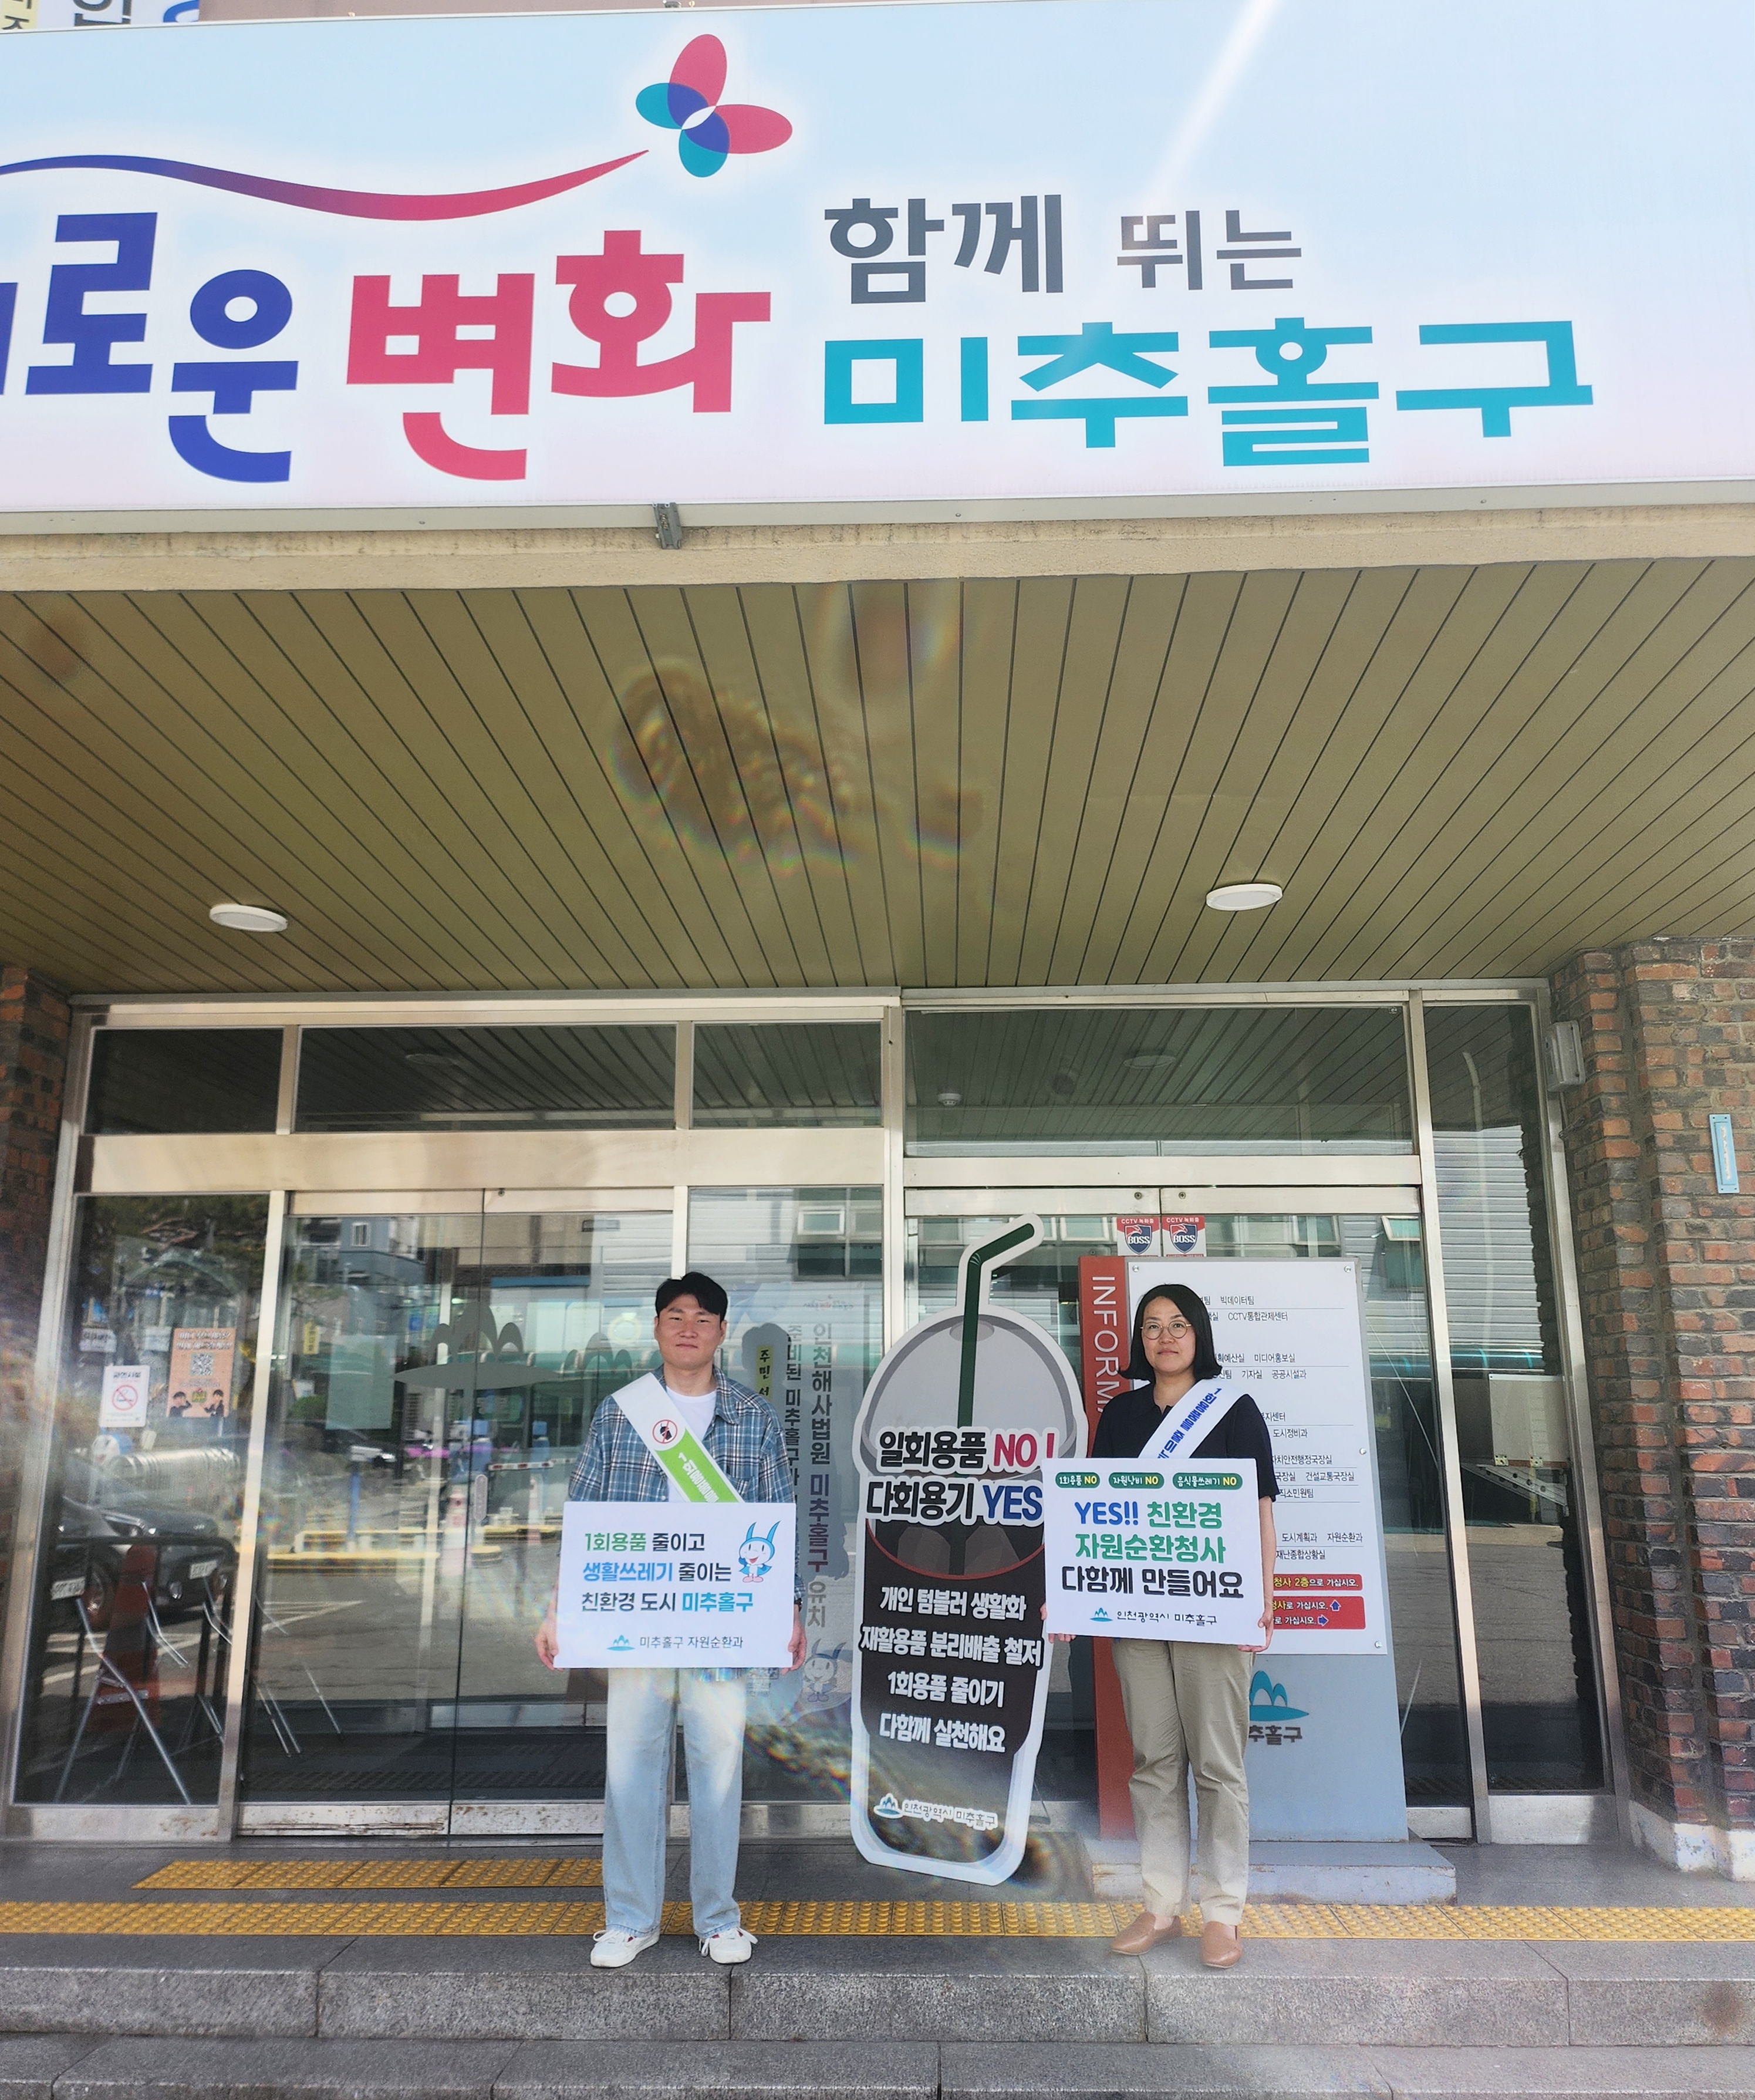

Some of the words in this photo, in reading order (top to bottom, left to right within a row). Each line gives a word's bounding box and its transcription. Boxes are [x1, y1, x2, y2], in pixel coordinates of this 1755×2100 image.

[825, 194, 1063, 304] 함께
[1117, 210, 1302, 291] 뛰는
[0, 213, 299, 483] 로운
[347, 230, 771, 481] 변화
[824, 317, 1593, 466] 미추홀구
[1128, 1236, 1150, 1244] BOSS
[1220, 1296, 1254, 1305] 빅데이터팀
[1228, 1312, 1288, 1321] CCTV통합관제센터
[1092, 1276, 1119, 1413] INFORM
[1215, 1353, 1244, 1363] 획예산실
[1254, 1353, 1295, 1363] 미디어홍보실
[1242, 1370, 1262, 1379] 기자실
[1272, 1370, 1306, 1379] 공공시설과
[811, 1322, 832, 1465] 인천해사법원
[1273, 1428, 1307, 1438] 도시정비과
[880, 1431, 987, 1468] 일회용품
[994, 1434, 1037, 1468] NO
[1059, 1477, 1082, 1485] 1회용품
[1084, 1476, 1098, 1485] NO
[1113, 1476, 1143, 1486] 자원낭비
[1145, 1476, 1159, 1485] NO
[1177, 1477, 1220, 1487] 음식물쓰레기
[1223, 1477, 1237, 1486] NO
[1306, 1472, 1354, 1481] 건설교통국장실
[867, 1481, 974, 1519] 다회용기
[983, 1485, 1042, 1521] YES
[1280, 1488, 1314, 1498] 직소민원팀
[808, 1474, 829, 1573] 미추홀구
[1075, 1501, 1138, 1525] YES!!
[1147, 1502, 1221, 1529] 친환경
[585, 1533, 646, 1551] 1회용품
[653, 1533, 704, 1551] 줄이고
[1282, 1532, 1317, 1542] 도시계획과
[1327, 1532, 1362, 1542] 자원순환과
[1075, 1533, 1226, 1563] 자원순환청사
[1276, 1549, 1325, 1560] 재난종합상황실
[583, 1562, 672, 1581] 생활쓰레기
[679, 1563, 731, 1581] 줄이는
[1062, 1566, 1133, 1593] 다함께
[1142, 1569, 1244, 1598] 만들어요
[1295, 1577, 1324, 1587] 2층으로
[1327, 1579, 1359, 1587] 가십시오.
[582, 1592, 635, 1612] 친환경
[641, 1593, 676, 1611] 도시
[683, 1592, 753, 1612] 미추홀구
[808, 1581, 826, 1628] 유치
[880, 1587, 914, 1613] 개인
[917, 1589, 967, 1616] 텀블러
[971, 1592, 1027, 1621] 생활화
[1297, 1602, 1328, 1610] 가십시오.
[1118, 1611, 1169, 1623] 인천광역시
[1174, 1614, 1217, 1626] 미추홀구
[640, 1636, 683, 1649] 미추홀구
[688, 1636, 743, 1648] 자원순환과
[860, 1626, 927, 1656] 재활용품
[930, 1632, 1000, 1663] 분리배출
[1004, 1637, 1042, 1667] 철저
[887, 1671, 947, 1702] 1회용품
[951, 1677, 1004, 1708] 줄이기
[880, 1713, 932, 1744] 다함께
[934, 1718, 1005, 1753] 실천해요
[905, 1803, 952, 1818] 인천광역시
[956, 1811, 995, 1826] 미추홀구
